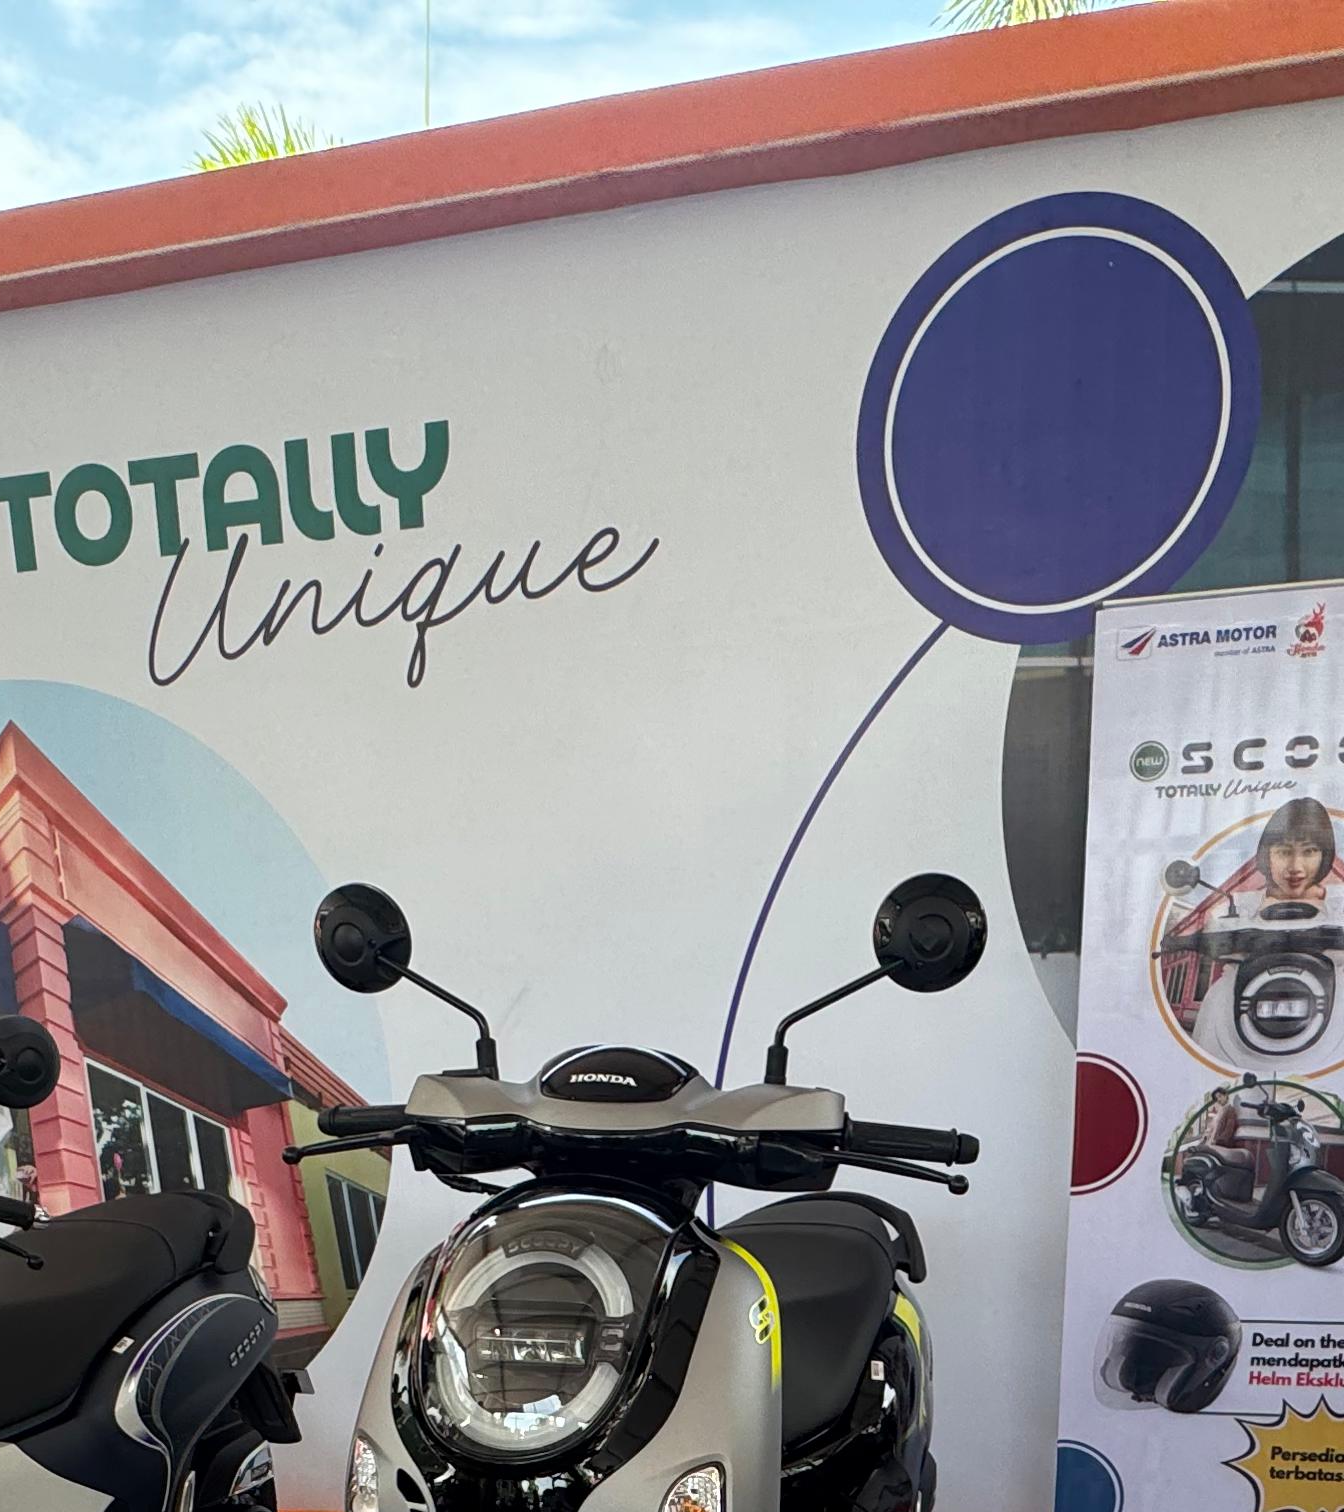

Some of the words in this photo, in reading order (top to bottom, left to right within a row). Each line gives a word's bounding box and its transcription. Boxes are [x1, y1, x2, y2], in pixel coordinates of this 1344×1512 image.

[148, 526, 660, 689] Unique
[1157, 629, 1211, 648] ASTRA
[1216, 624, 1277, 643] MOTOR
[1156, 783, 1223, 799] TOTALLY
[1223, 778, 1298, 800] Unique
[569, 1073, 638, 1087] HONDA
[229, 1317, 266, 1367] SCOOPY
[1251, 1332, 1290, 1348] Deal
[1293, 1338, 1315, 1349] on
[1248, 1371, 1292, 1386] Helm
